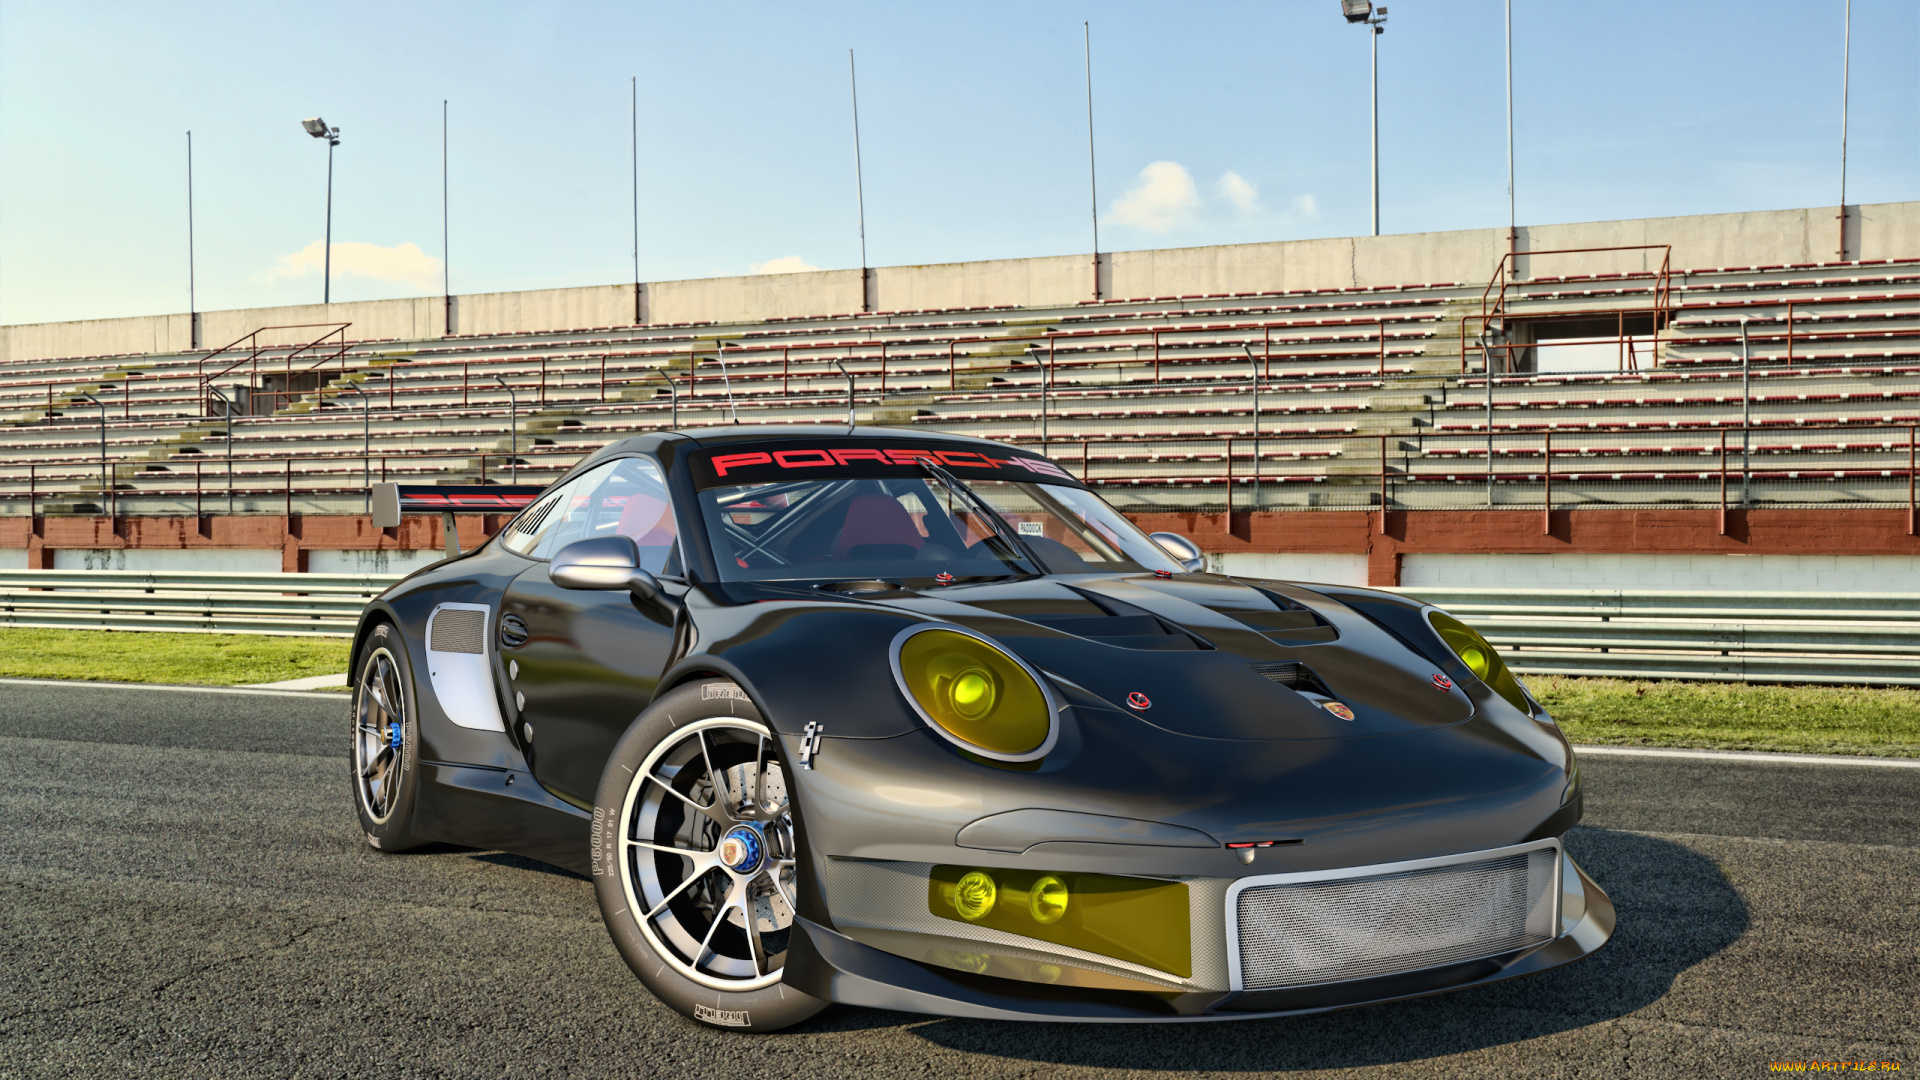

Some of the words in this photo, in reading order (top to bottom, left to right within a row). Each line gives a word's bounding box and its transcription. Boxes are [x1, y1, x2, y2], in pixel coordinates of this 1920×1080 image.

[711, 449, 1075, 481] PORSCHE
[1020, 523, 1042, 533] PADDOCK
[609, 807, 616, 816] W
[608, 819, 614, 828] 91
[591, 806, 605, 876] P6000
[606, 830, 612, 839] 17
[606, 852, 615, 877] 225/50
[694, 1004, 751, 1026] PIRELLI
